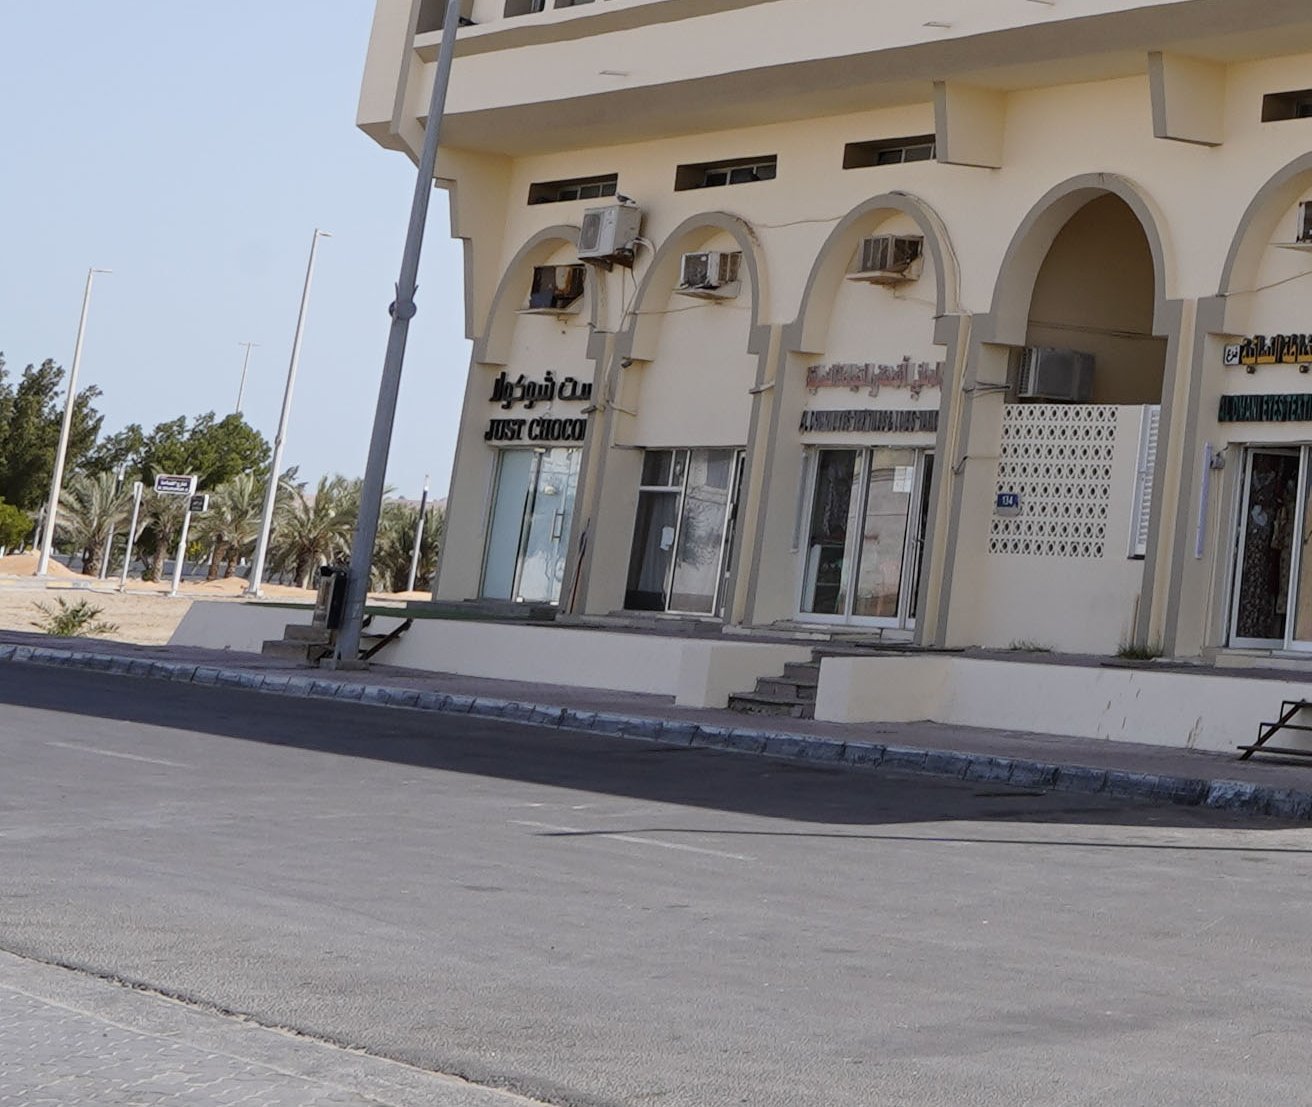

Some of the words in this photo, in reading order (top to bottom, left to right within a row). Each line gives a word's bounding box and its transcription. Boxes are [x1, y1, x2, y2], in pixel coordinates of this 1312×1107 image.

[489, 370, 556, 410] شوكولا
[484, 419, 526, 441] JUST
[1002, 496, 1014, 505] 134
